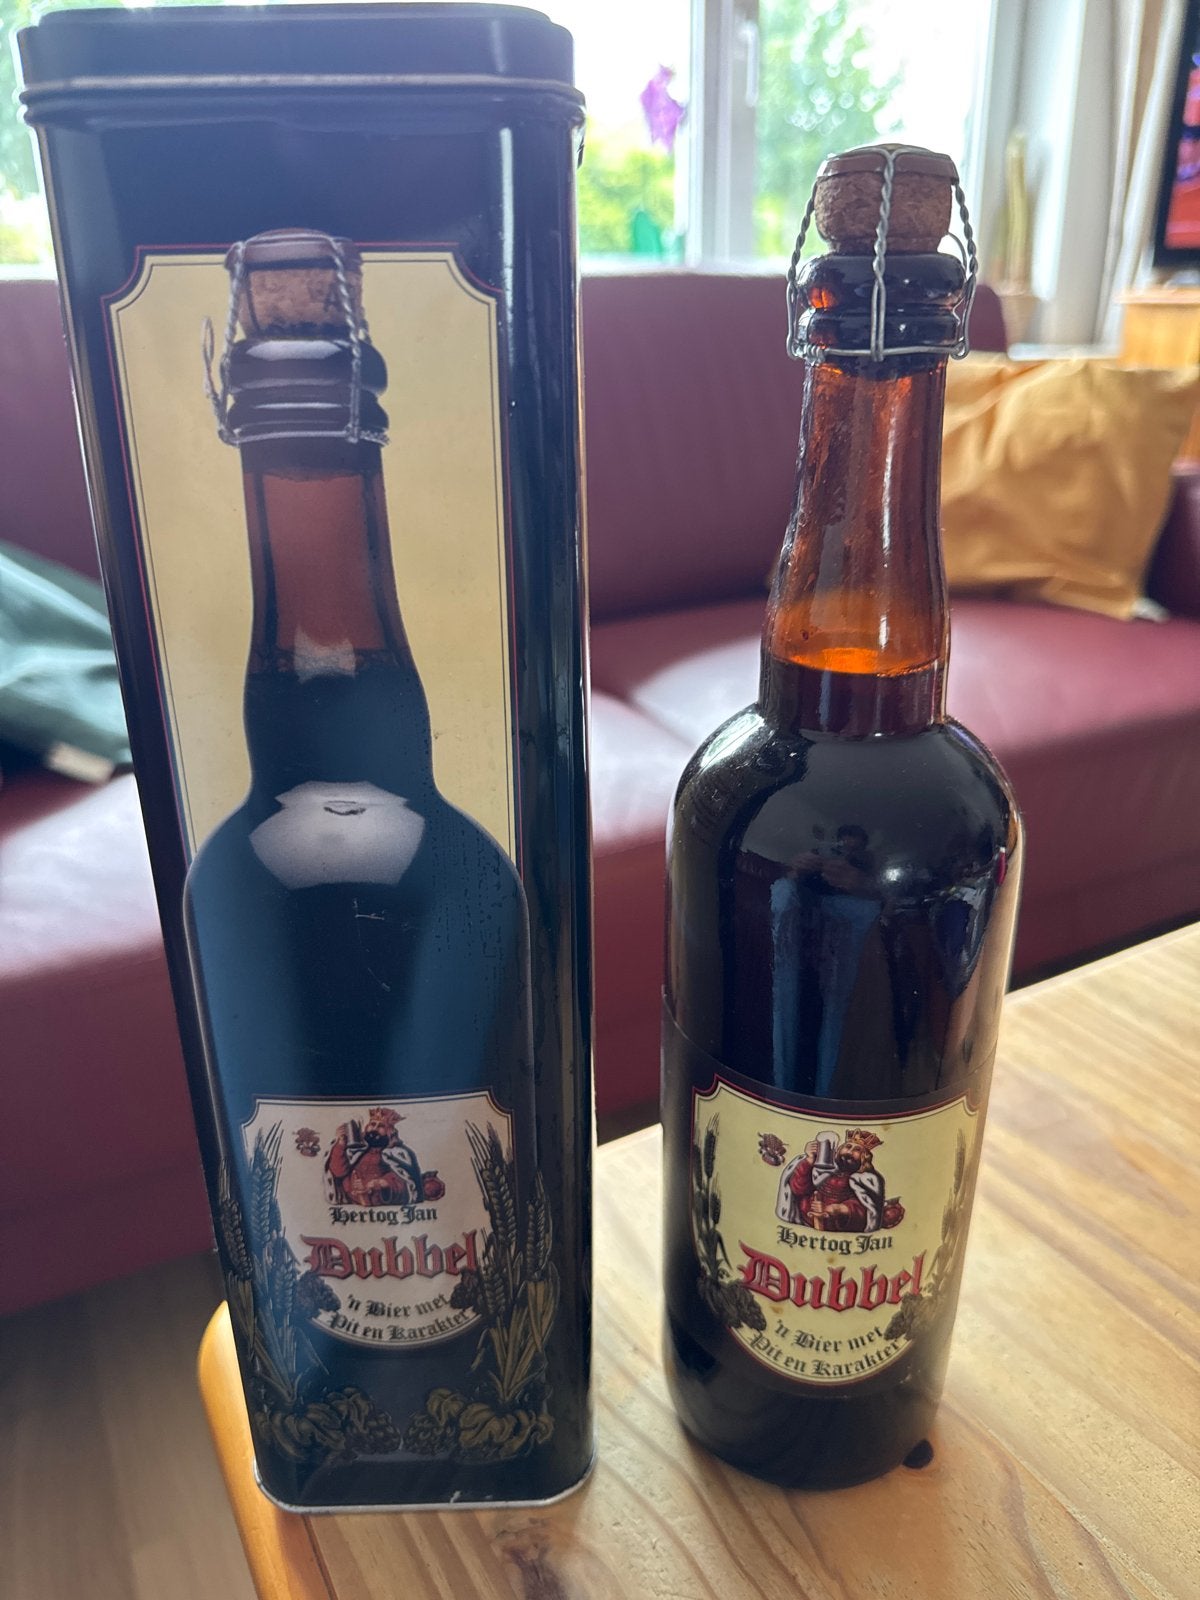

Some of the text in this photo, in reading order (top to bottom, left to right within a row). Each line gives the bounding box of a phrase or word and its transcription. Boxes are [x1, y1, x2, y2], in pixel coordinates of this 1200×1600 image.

[329, 1205, 438, 1226] Hertog Jan
[300, 1229, 478, 1280] Dubbel
[776, 1225, 893, 1255] Hertog Jan
[737, 1239, 927, 1312] Dubbel
[365, 1300, 410, 1318] Bier
[415, 1293, 450, 1316] met
[327, 1309, 470, 1341] Pit en Karakter
[793, 1330, 842, 1352] Bier
[848, 1326, 883, 1350] met
[749, 1330, 900, 1377] Pit en Karakter
